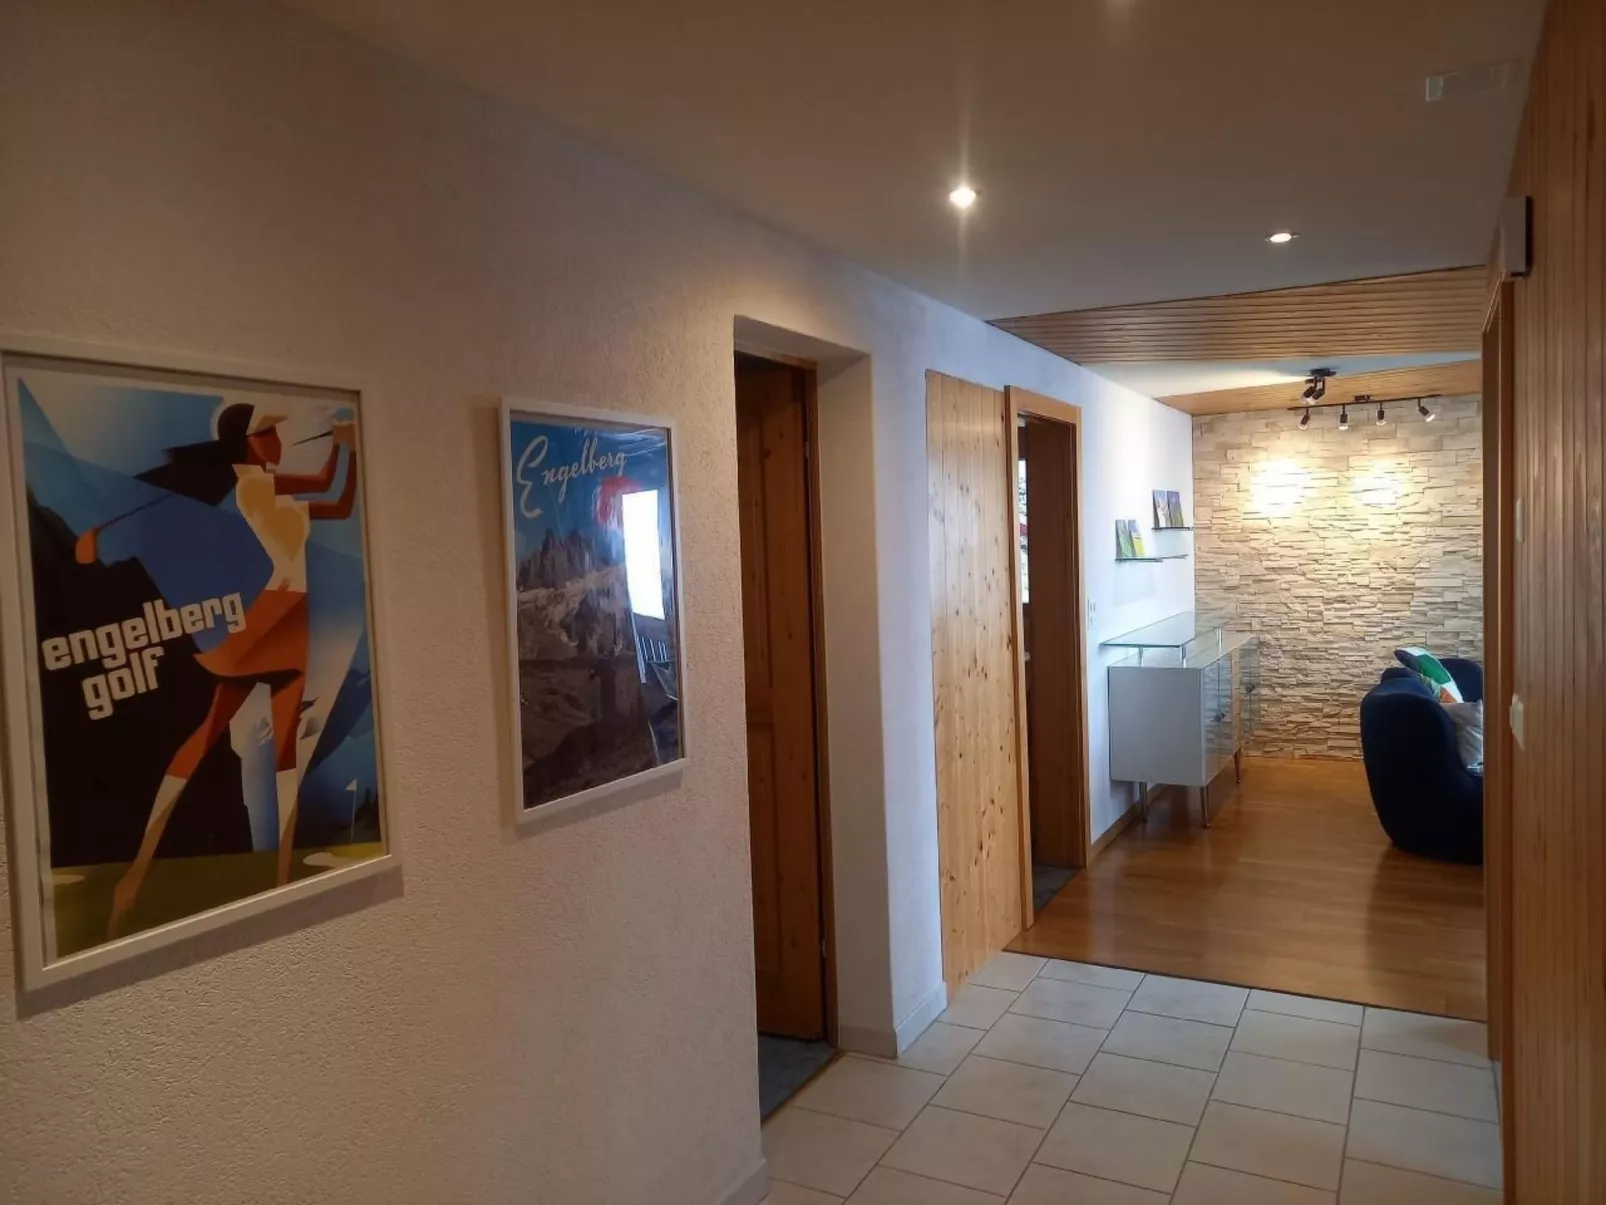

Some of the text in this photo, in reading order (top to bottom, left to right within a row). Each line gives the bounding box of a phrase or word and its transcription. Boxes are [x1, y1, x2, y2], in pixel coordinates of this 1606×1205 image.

[516, 435, 628, 519] Engelberg
[41, 591, 247, 671] engelberg
[81, 645, 165, 721] golf
